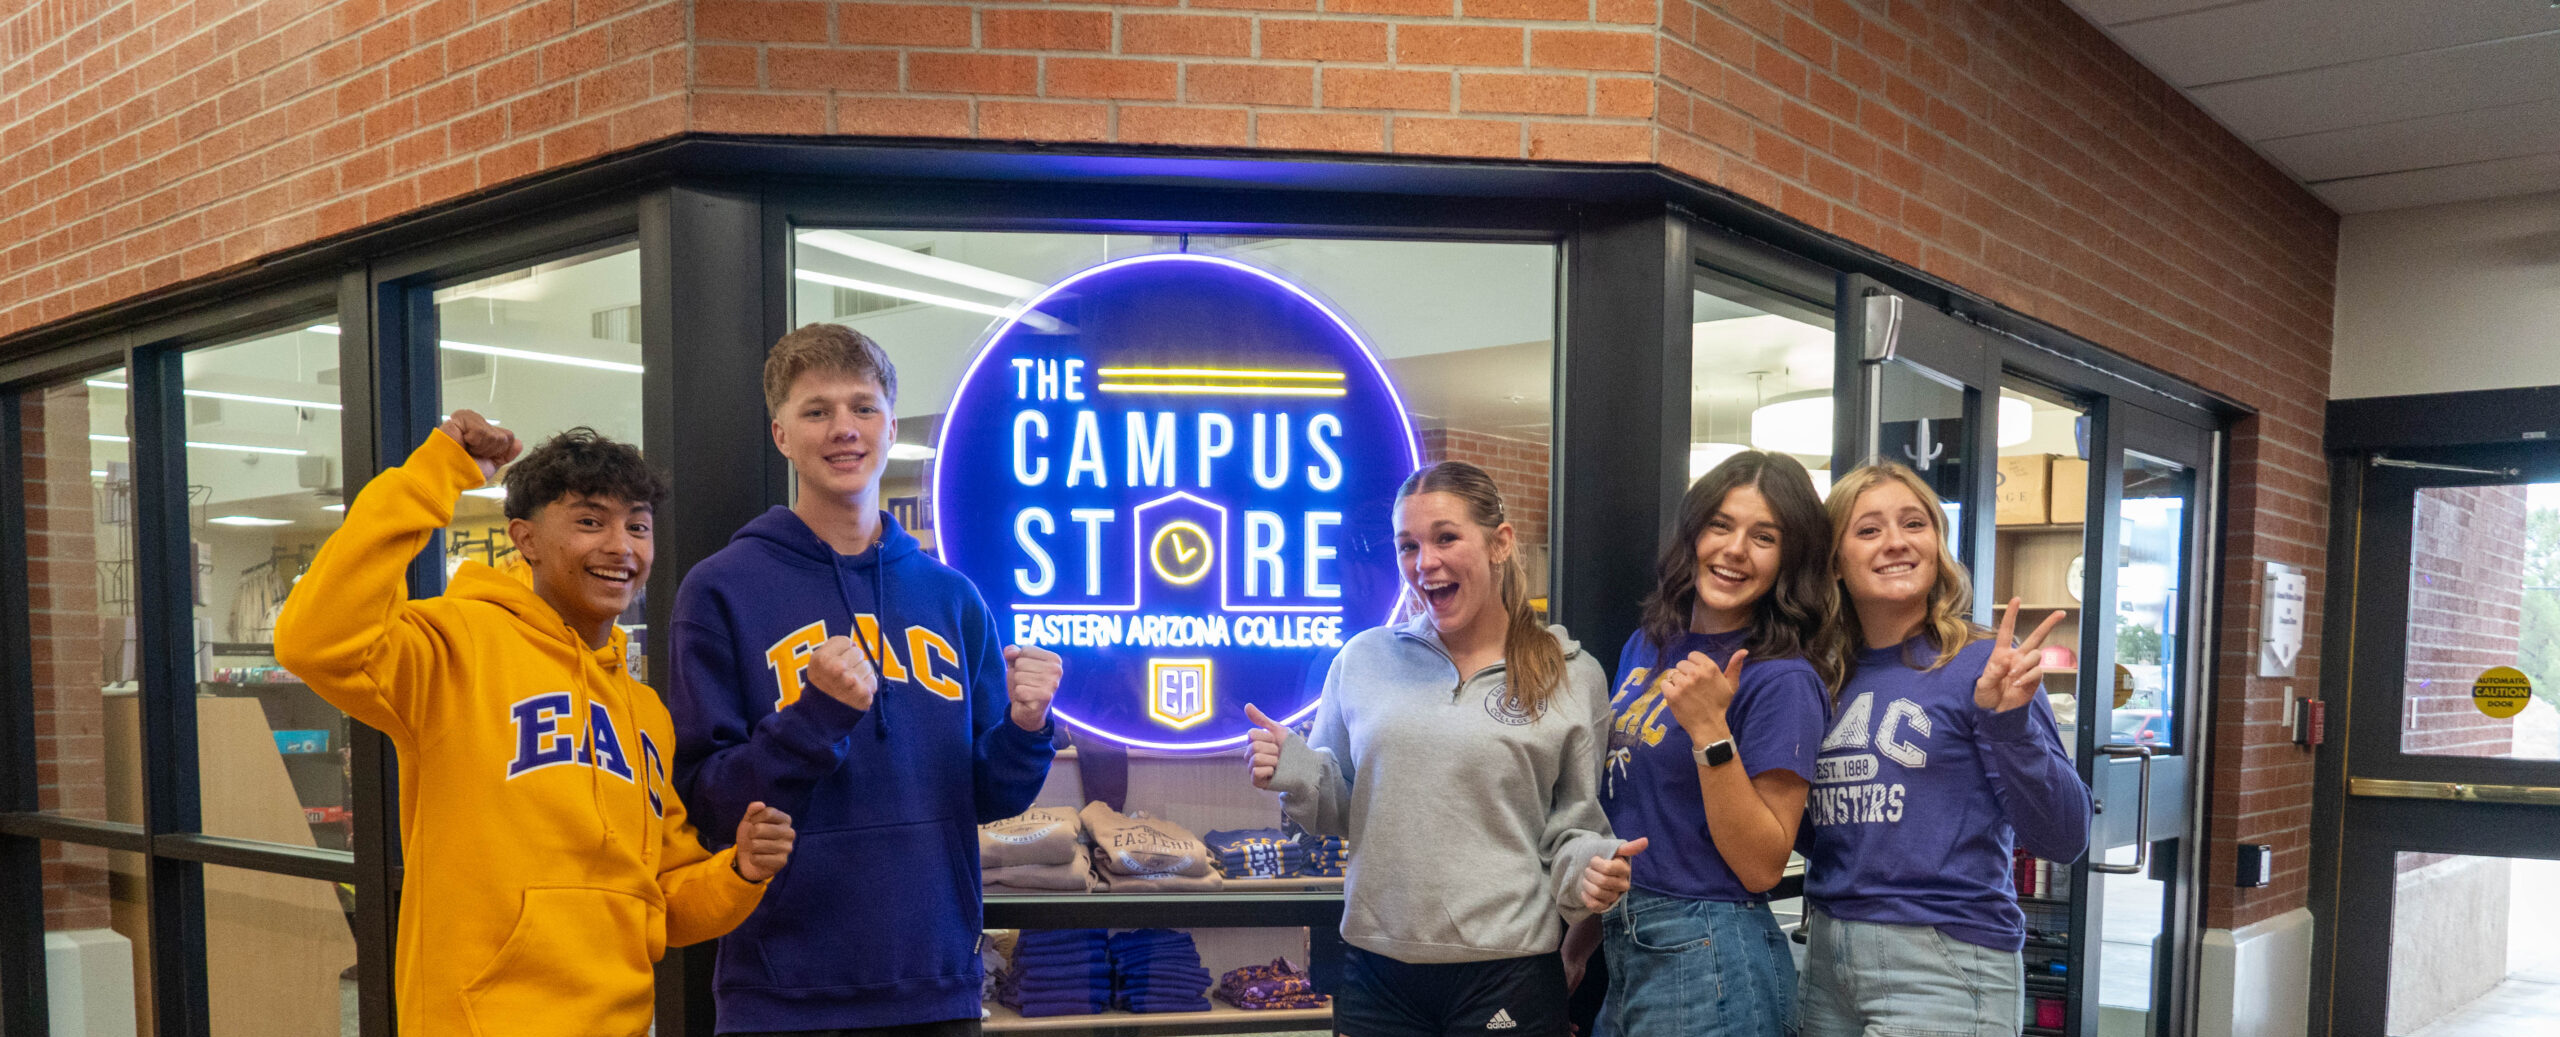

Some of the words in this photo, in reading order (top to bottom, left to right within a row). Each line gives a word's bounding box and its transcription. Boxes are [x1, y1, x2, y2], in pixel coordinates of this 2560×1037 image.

[1012, 358, 1085, 400] THE
[1013, 409, 1343, 491] CAMPUS
[1014, 614, 1122, 647] EASTERN
[1126, 615, 1231, 647] ARIZONA
[1234, 615, 1343, 648] COLLEGE
[1161, 669, 1199, 716] EA
[2474, 687, 2529, 697] CAUTION
[2477, 677, 2527, 685] AUTOMATIC
[1490, 707, 1530, 724] COLLEGE
[506, 691, 665, 820] EAC
[1843, 759, 1869, 777] 1888
[1811, 783, 1906, 825] ONSTERS
[1486, 1020, 1517, 1030] adidas
